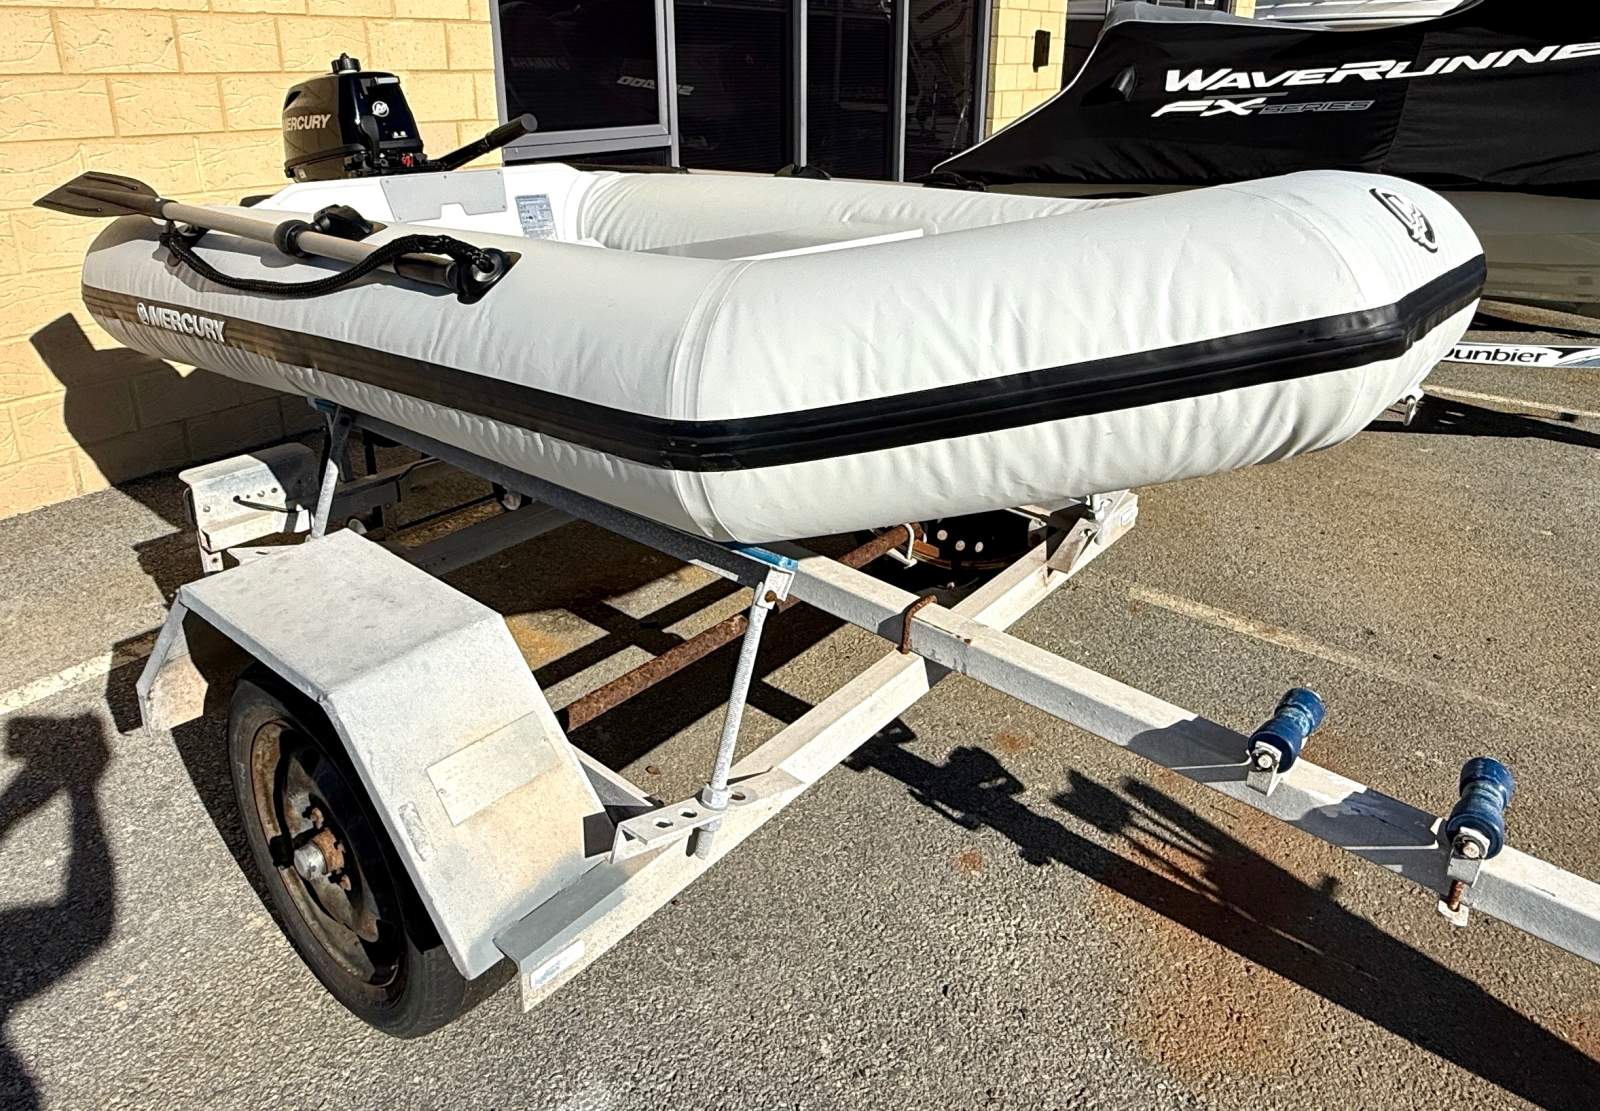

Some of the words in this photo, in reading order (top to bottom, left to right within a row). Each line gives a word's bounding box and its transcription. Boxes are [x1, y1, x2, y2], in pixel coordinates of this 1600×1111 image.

[1151, 97, 1267, 117] FX
[1258, 100, 1375, 114] SERIES
[285, 114, 331, 131] ERCURY
[148, 305, 225, 342] MERCURY
